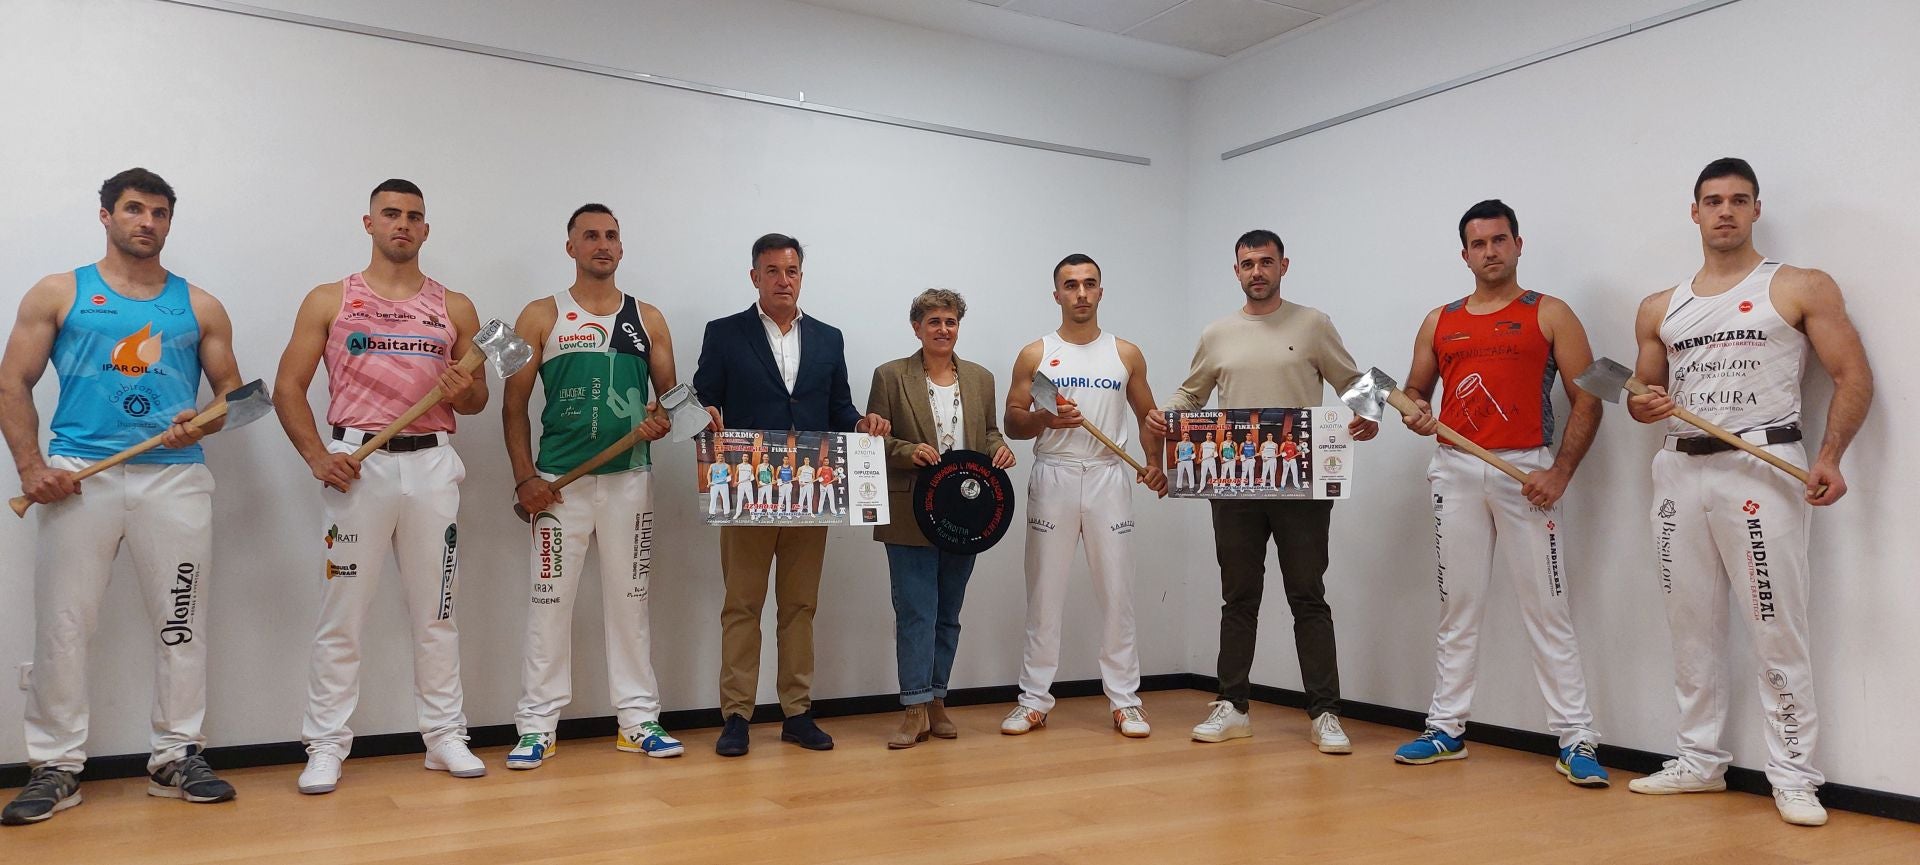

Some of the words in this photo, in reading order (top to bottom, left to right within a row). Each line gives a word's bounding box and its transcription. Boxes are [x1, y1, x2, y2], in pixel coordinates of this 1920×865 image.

[350, 337, 444, 356] Albaitaritza
[558, 333, 595, 343] Euskadi
[559, 341, 596, 350] LowCost
[1673, 329, 1767, 352] MENDIZABAL
[102, 363, 128, 373] IPAR
[131, 365, 150, 374] OIL
[108, 383, 161, 406] Gabirondo
[1689, 391, 1757, 405] ESKURA
[714, 431, 760, 439] EUSKADIKO
[335, 533, 358, 542] IRATI
[540, 527, 551, 579] Euskadi
[552, 526, 562, 578] LowCost
[1549, 533, 1562, 596] MENDIZABAL
[1746, 518, 1775, 621] MENDIZABAL
[1779, 692, 1803, 760] ESKURA
